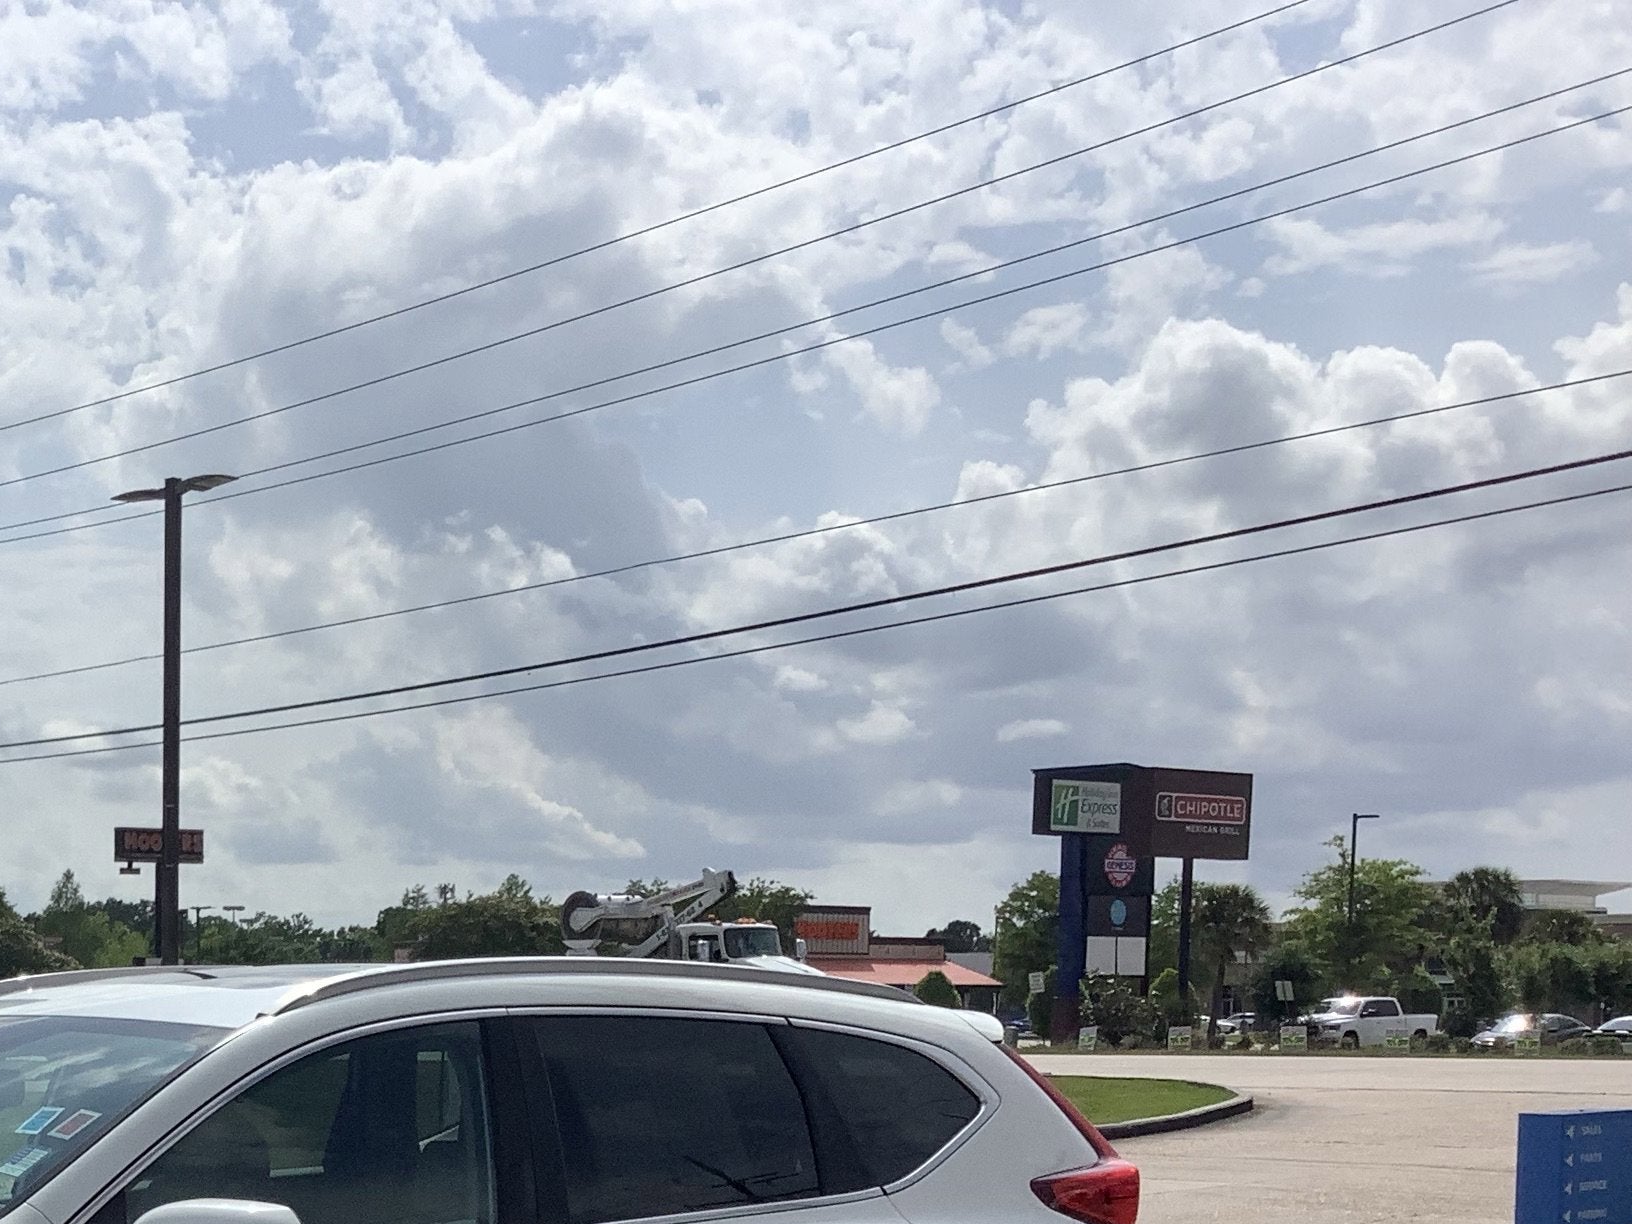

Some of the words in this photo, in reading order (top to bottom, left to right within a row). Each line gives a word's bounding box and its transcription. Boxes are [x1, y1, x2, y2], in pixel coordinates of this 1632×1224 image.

[1080, 799, 1119, 817] Express
[1176, 800, 1243, 818] CHIPOTLE
[1185, 825, 1218, 834] MEXICAN
